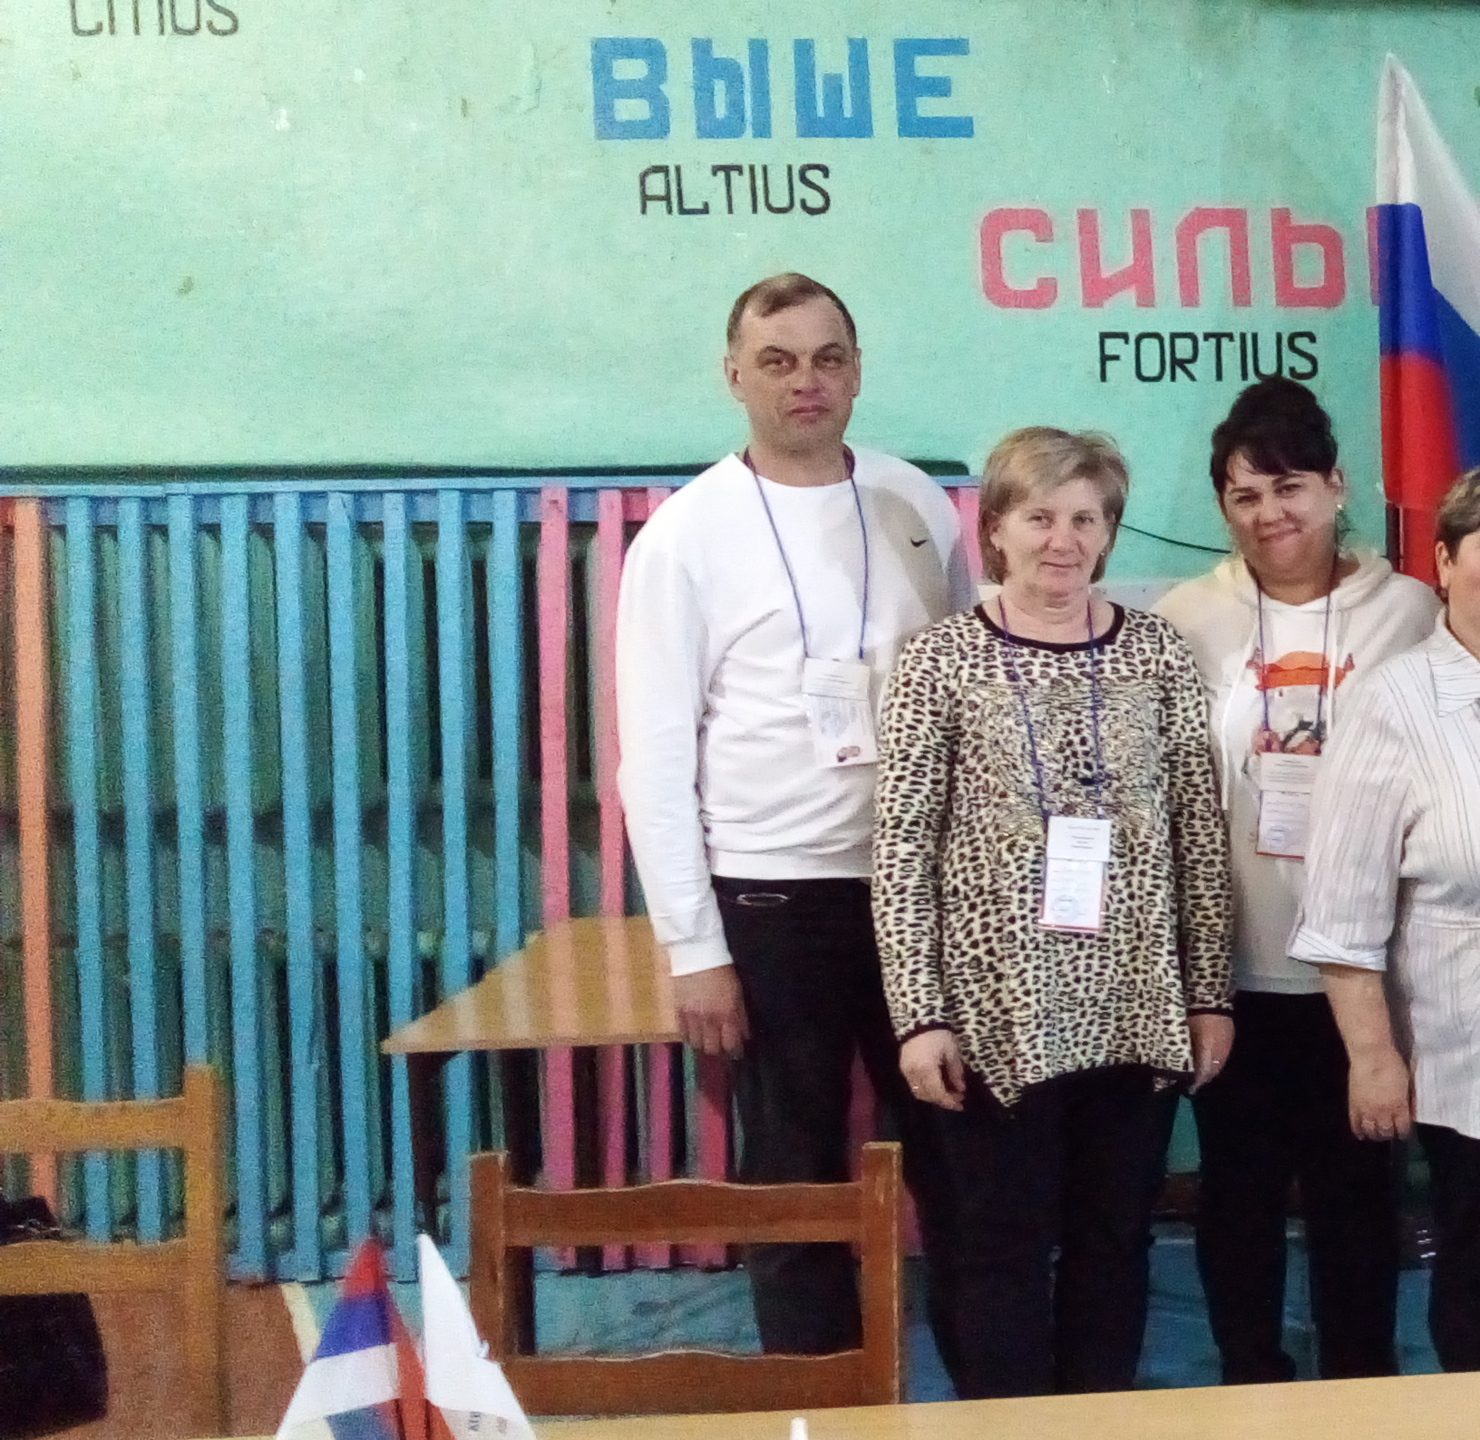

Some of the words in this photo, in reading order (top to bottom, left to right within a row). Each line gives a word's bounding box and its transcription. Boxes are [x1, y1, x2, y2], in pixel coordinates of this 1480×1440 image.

[591, 37, 974, 140] ВЫШЕ
[639, 164, 831, 215] ALTIUS
[1099, 331, 1319, 383] FORTIUS
